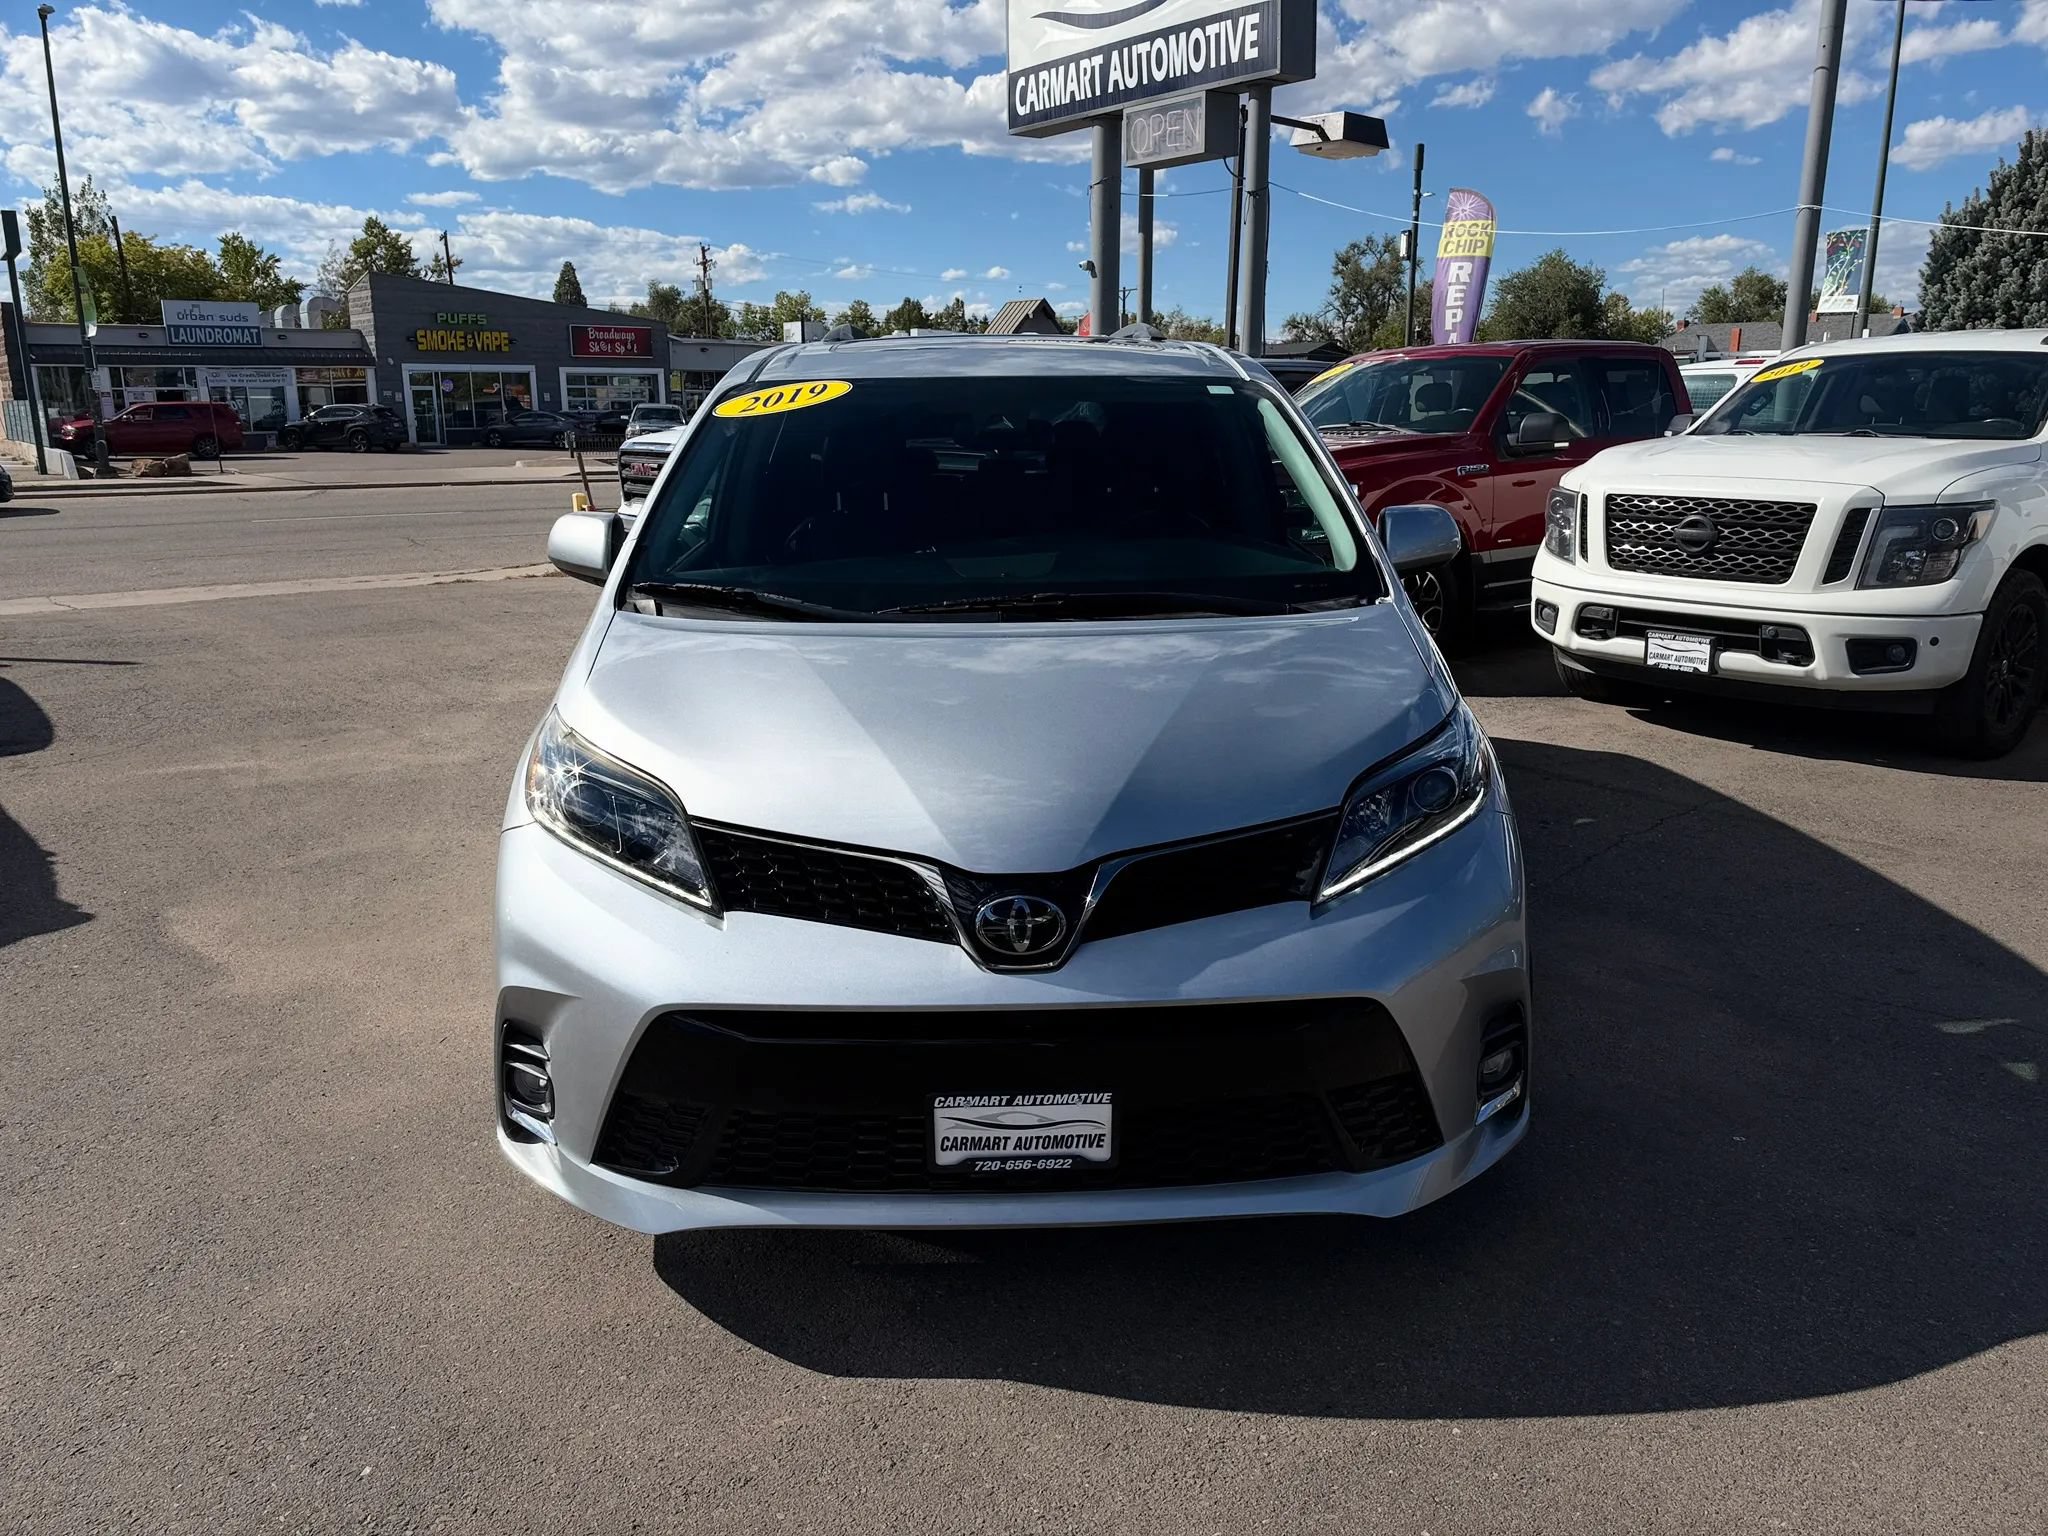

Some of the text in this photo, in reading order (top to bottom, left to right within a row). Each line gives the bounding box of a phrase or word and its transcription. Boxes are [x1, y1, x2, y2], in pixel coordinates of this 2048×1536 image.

[1015, 12, 1261, 117] CARMART AUTOMOTIVE
[1130, 106, 1201, 155] OPEN
[1443, 222, 1492, 238] ROCK
[1443, 239, 1486, 254] CHIP
[176, 308, 249, 322] urban suds
[436, 312, 488, 325] PUFFS
[170, 327, 258, 344] LAUNDROMAT
[587, 327, 636, 343] Broadways
[738, 383, 828, 413] 2019
[1649, 652, 1707, 665] CARMART AUTOMOTIVE
[933, 1092, 1113, 1108] CARMART AUTOMOTIVE
[940, 1133, 1107, 1152] CARMART AUTOMOTIVE
[974, 1158, 1073, 1172] 720-656-6922
